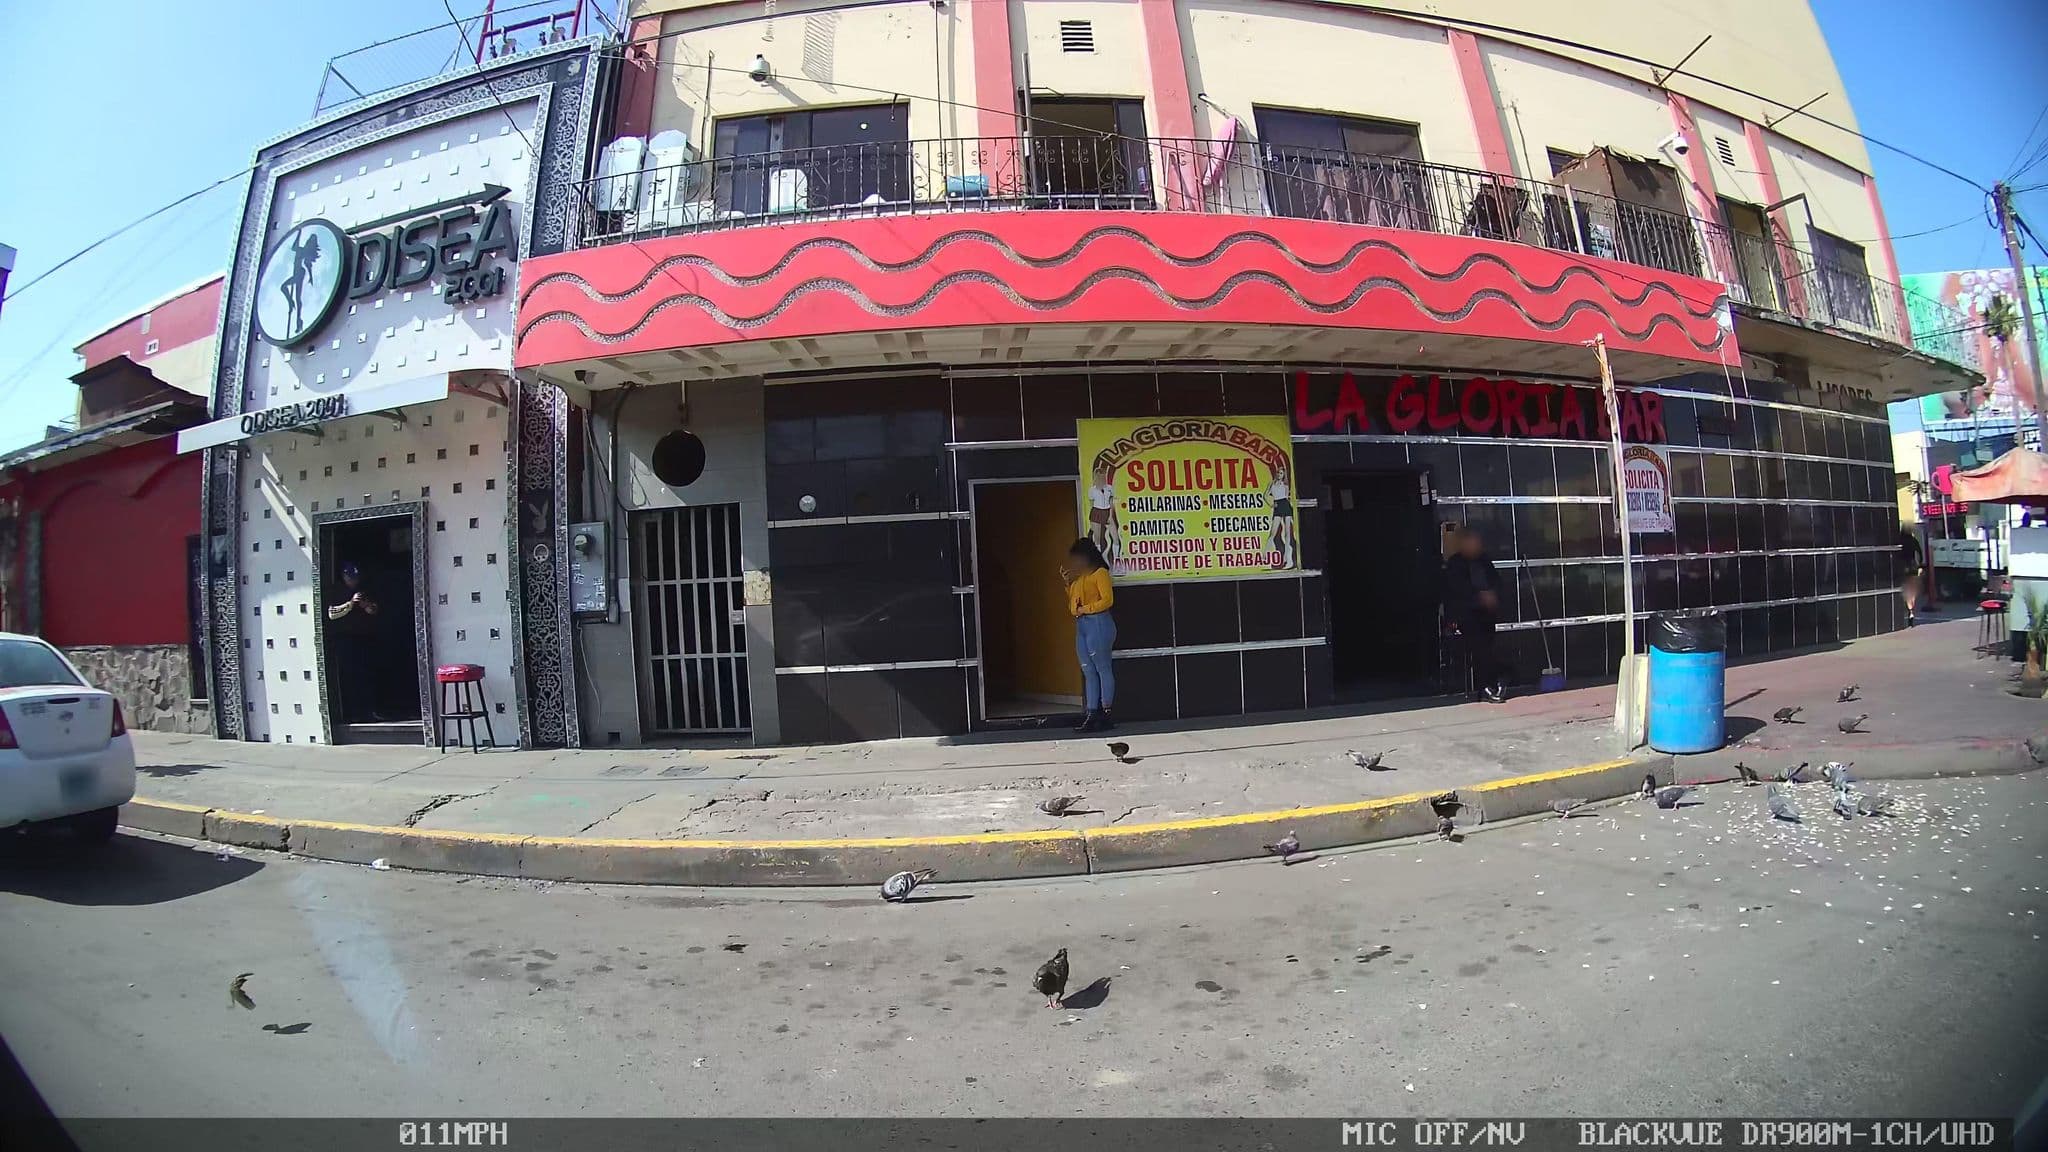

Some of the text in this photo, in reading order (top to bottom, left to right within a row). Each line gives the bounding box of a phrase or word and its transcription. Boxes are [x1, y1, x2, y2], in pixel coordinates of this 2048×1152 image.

[443, 265, 505, 305] 2001
[1296, 372, 1368, 432] LA
[1386, 373, 1587, 437] GLORIA
[1101, 422, 1280, 467] LA GLORIA BAR
[1127, 458, 1260, 493] SOLICITA
[1128, 492, 1264, 513] BAILARINAS MESERAS
[1130, 515, 1270, 536] DAMITAS EDECANES
[1129, 535, 1262, 556] COMISION Y BUEN
[1194, 554, 1213, 569] DE
[1217, 551, 1283, 567] TRABAJO
